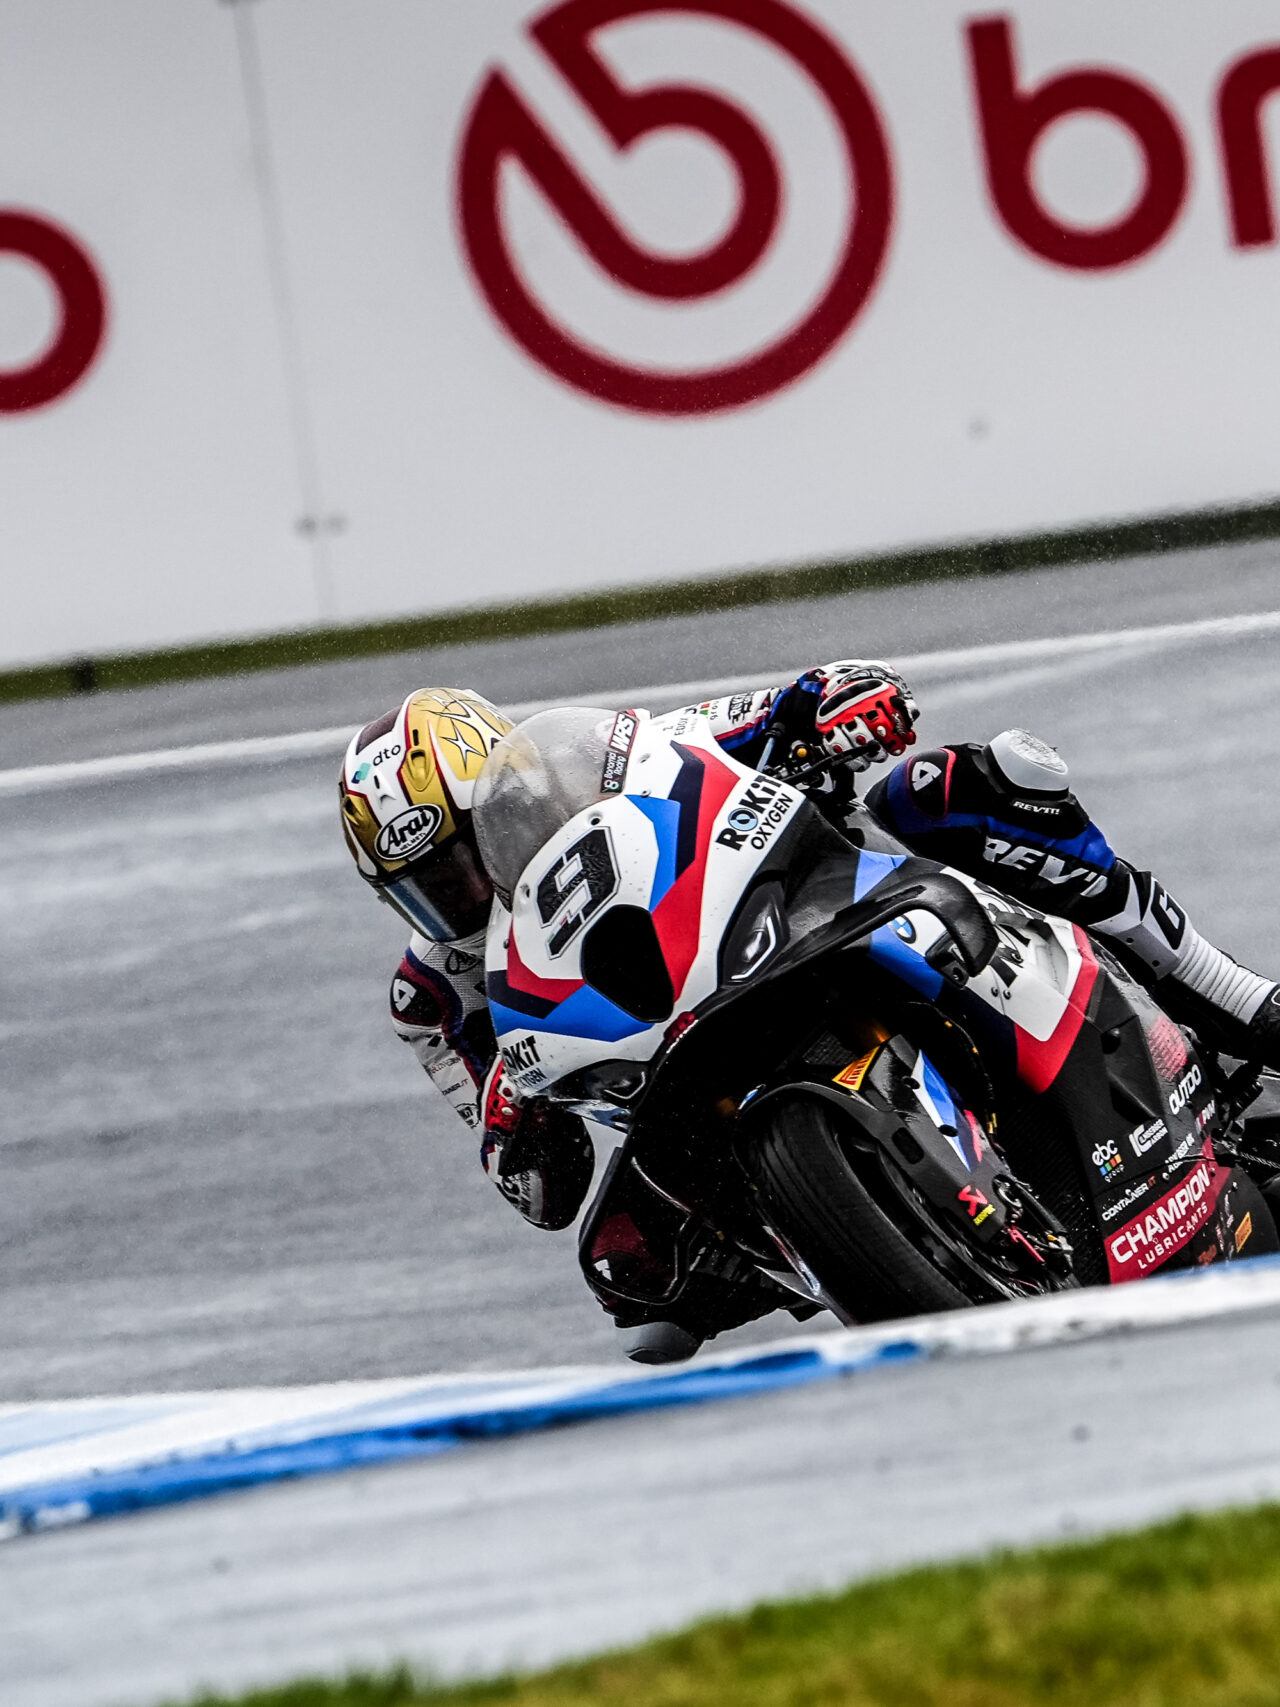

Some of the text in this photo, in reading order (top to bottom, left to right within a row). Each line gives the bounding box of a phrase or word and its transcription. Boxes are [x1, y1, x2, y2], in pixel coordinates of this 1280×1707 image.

[372, 744, 401, 766] dto
[609, 712, 635, 752] WRS
[379, 806, 432, 856] Arai
[750, 792, 793, 850] OXYGEN
[536, 826, 621, 960] 9
[1168, 1064, 1202, 1115] OUTDO
[1091, 1139, 1118, 1166] ebc
[1110, 1163, 1211, 1264] CHAMPION
[1137, 1201, 1209, 1270] LUBRICANTS
